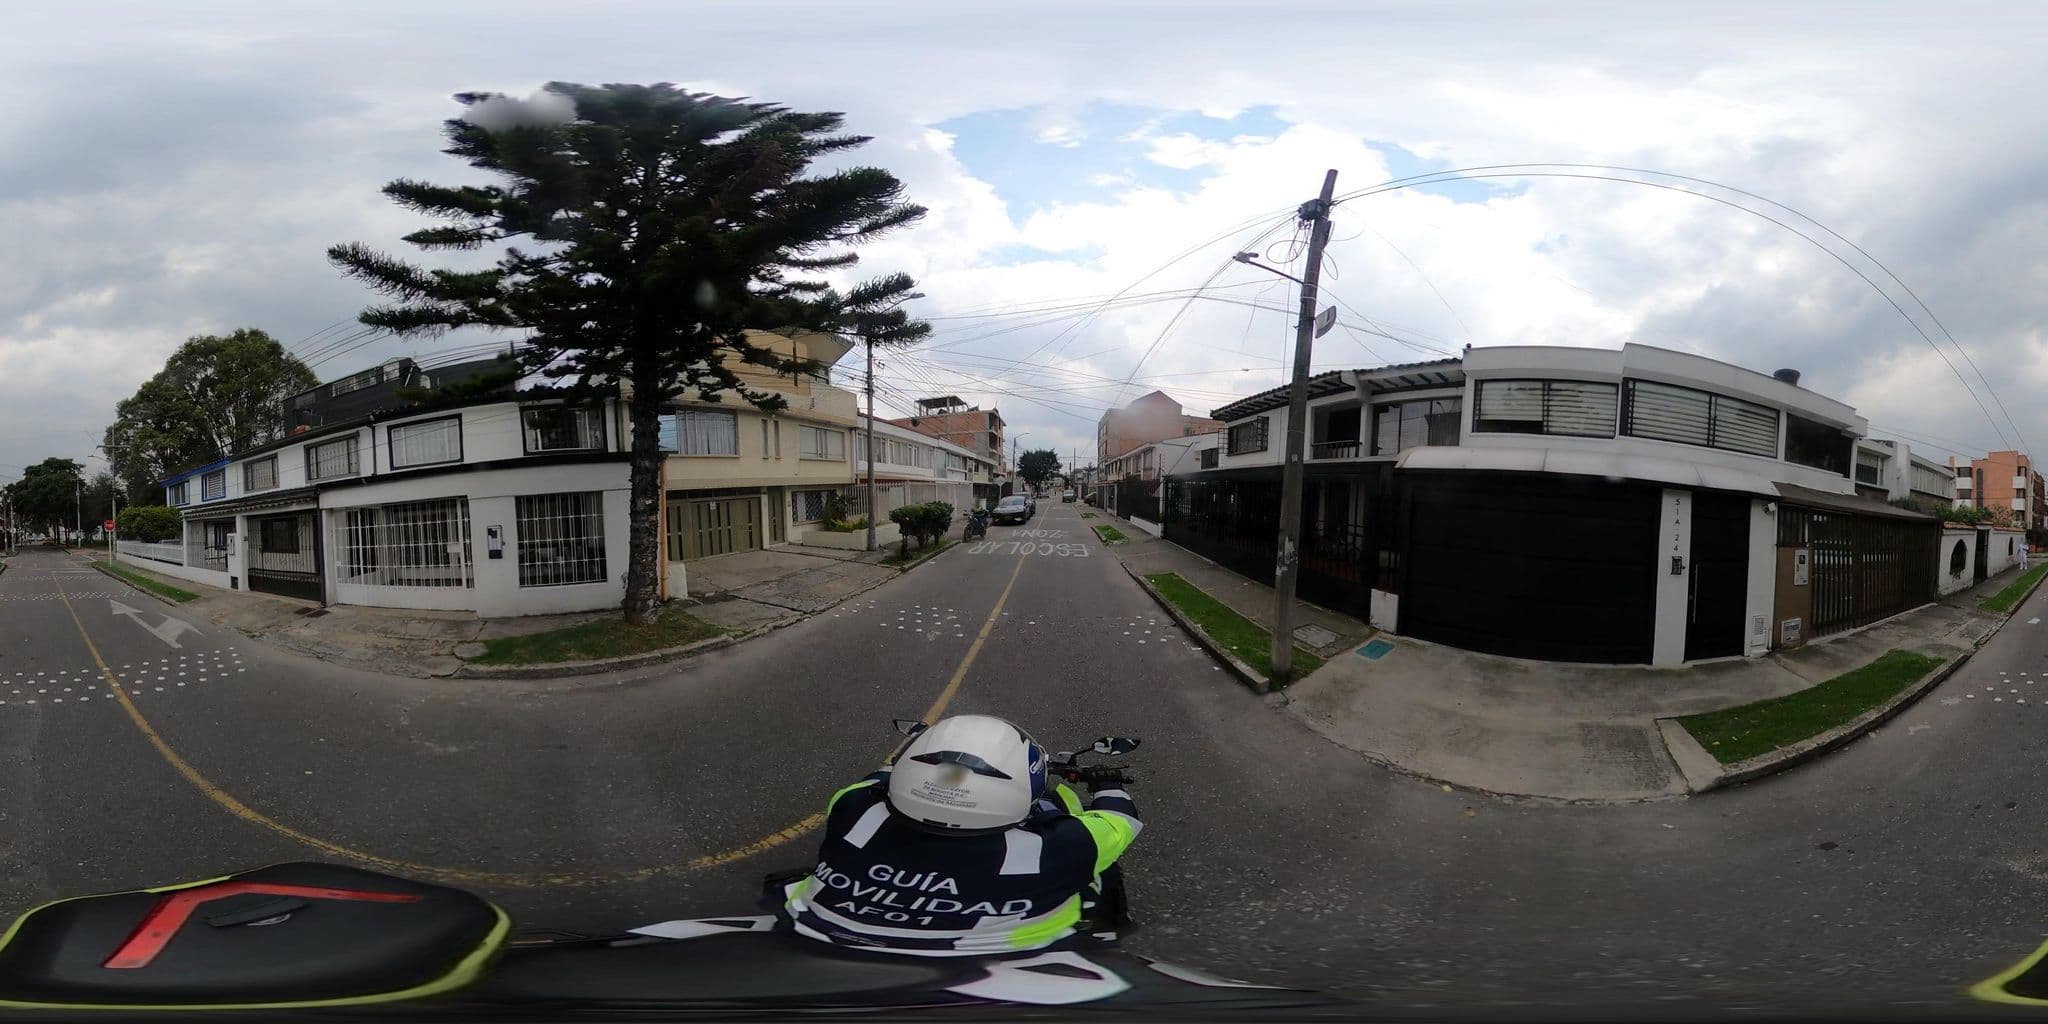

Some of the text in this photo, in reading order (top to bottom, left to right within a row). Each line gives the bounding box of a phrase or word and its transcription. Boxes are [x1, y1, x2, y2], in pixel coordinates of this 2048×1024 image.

[968, 541, 1089, 557] ESCOLAR
[815, 861, 1033, 915] MOVILIDAD
[868, 864, 959, 895] GUÍA
